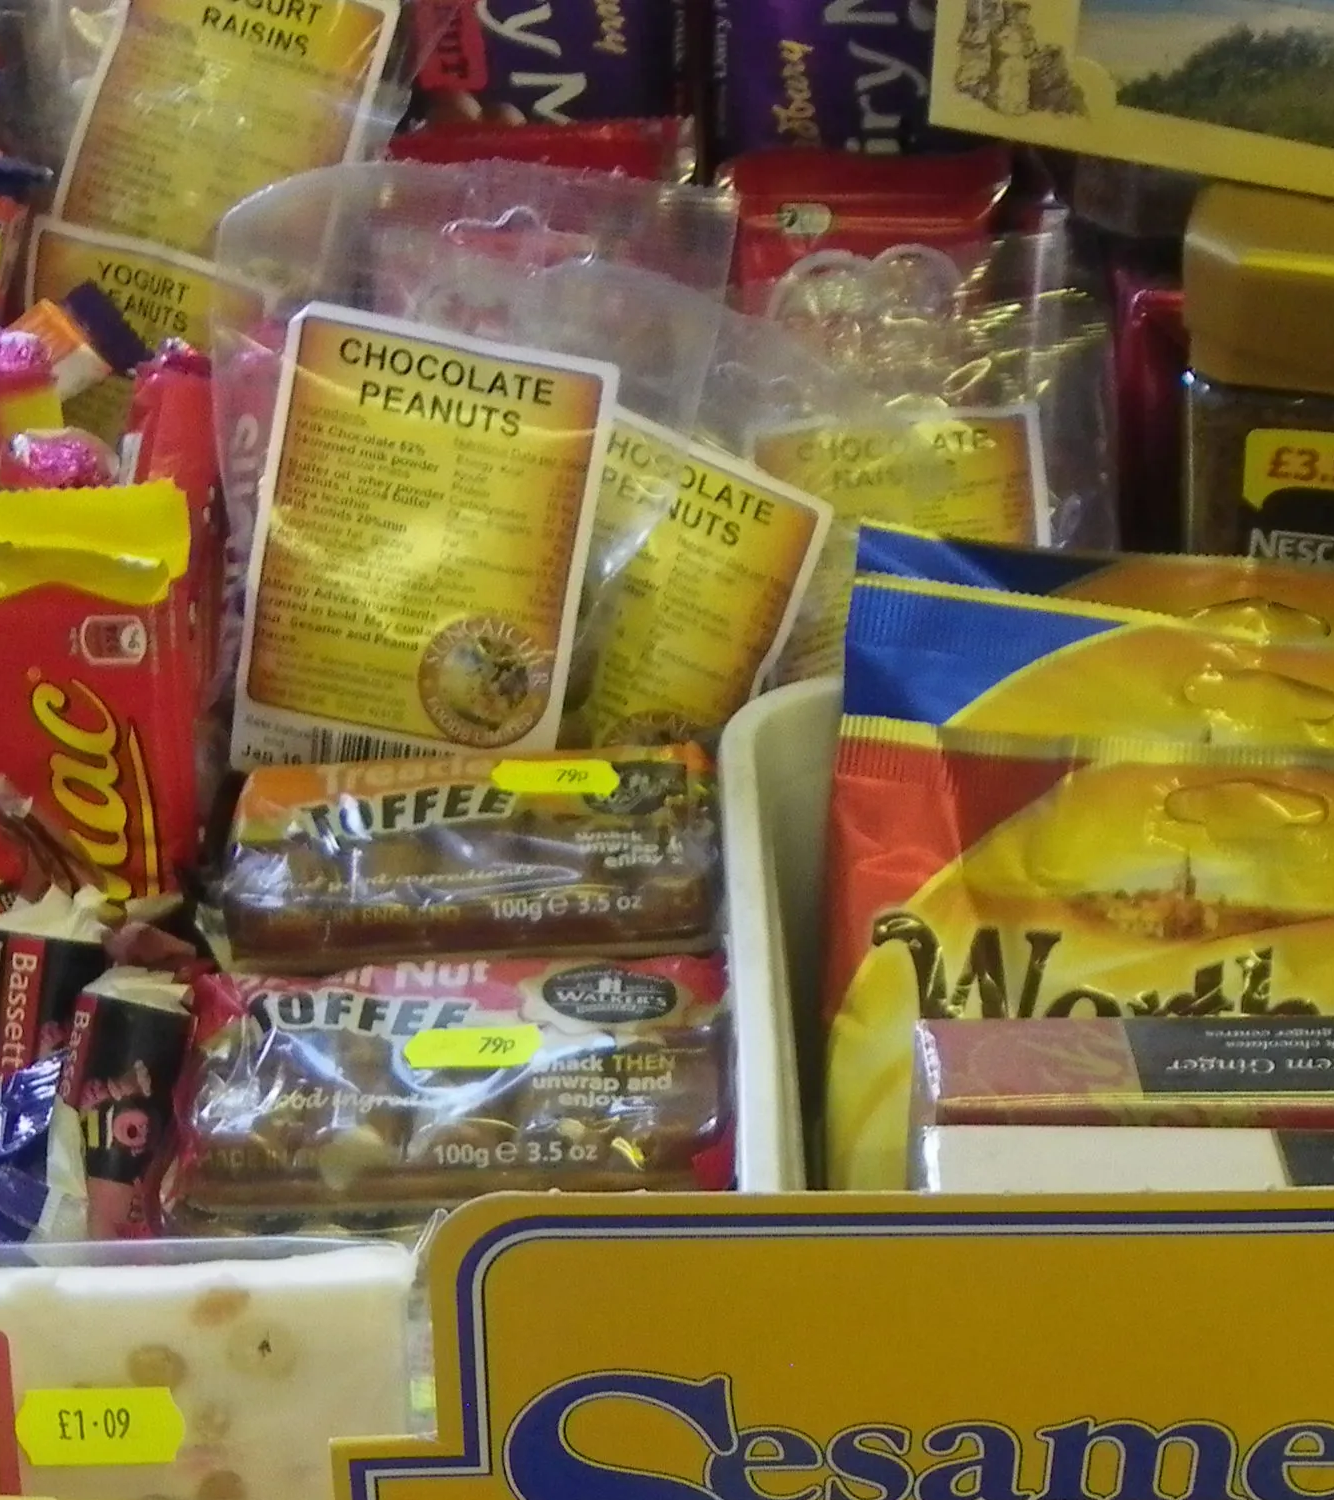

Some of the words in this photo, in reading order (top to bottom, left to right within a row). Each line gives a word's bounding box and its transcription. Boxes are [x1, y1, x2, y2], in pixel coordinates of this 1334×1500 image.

[201, 5, 310, 57] RAISINS
[98, 259, 191, 305] YOGURT
[108, 288, 188, 333] ANUTS
[338, 335, 556, 406] CHOCOLATE
[357, 380, 522, 438] PEANUTS
[604, 428, 775, 527] HOCOLATE
[555, 767, 589, 784] 79p
[489, 899, 543, 923] 100g
[577, 896, 611, 914] 3.5
[617, 894, 643, 912] oz
[393, 960, 490, 989] Nut
[2, 951, 38, 1068] Bassett
[478, 1035, 517, 1055] 79p
[1225, 1039, 1322, 1050] chocolates
[1284, 1026, 1333, 1038] ginger
[611, 1054, 676, 1071] THEN
[1165, 1053, 1276, 1075] Ginger
[531, 1072, 619, 1094] unwrap
[627, 1071, 674, 1091] and
[432, 1143, 490, 1169] 100g
[526, 1142, 563, 1161] 3.5
[569, 1143, 599, 1161] oz
